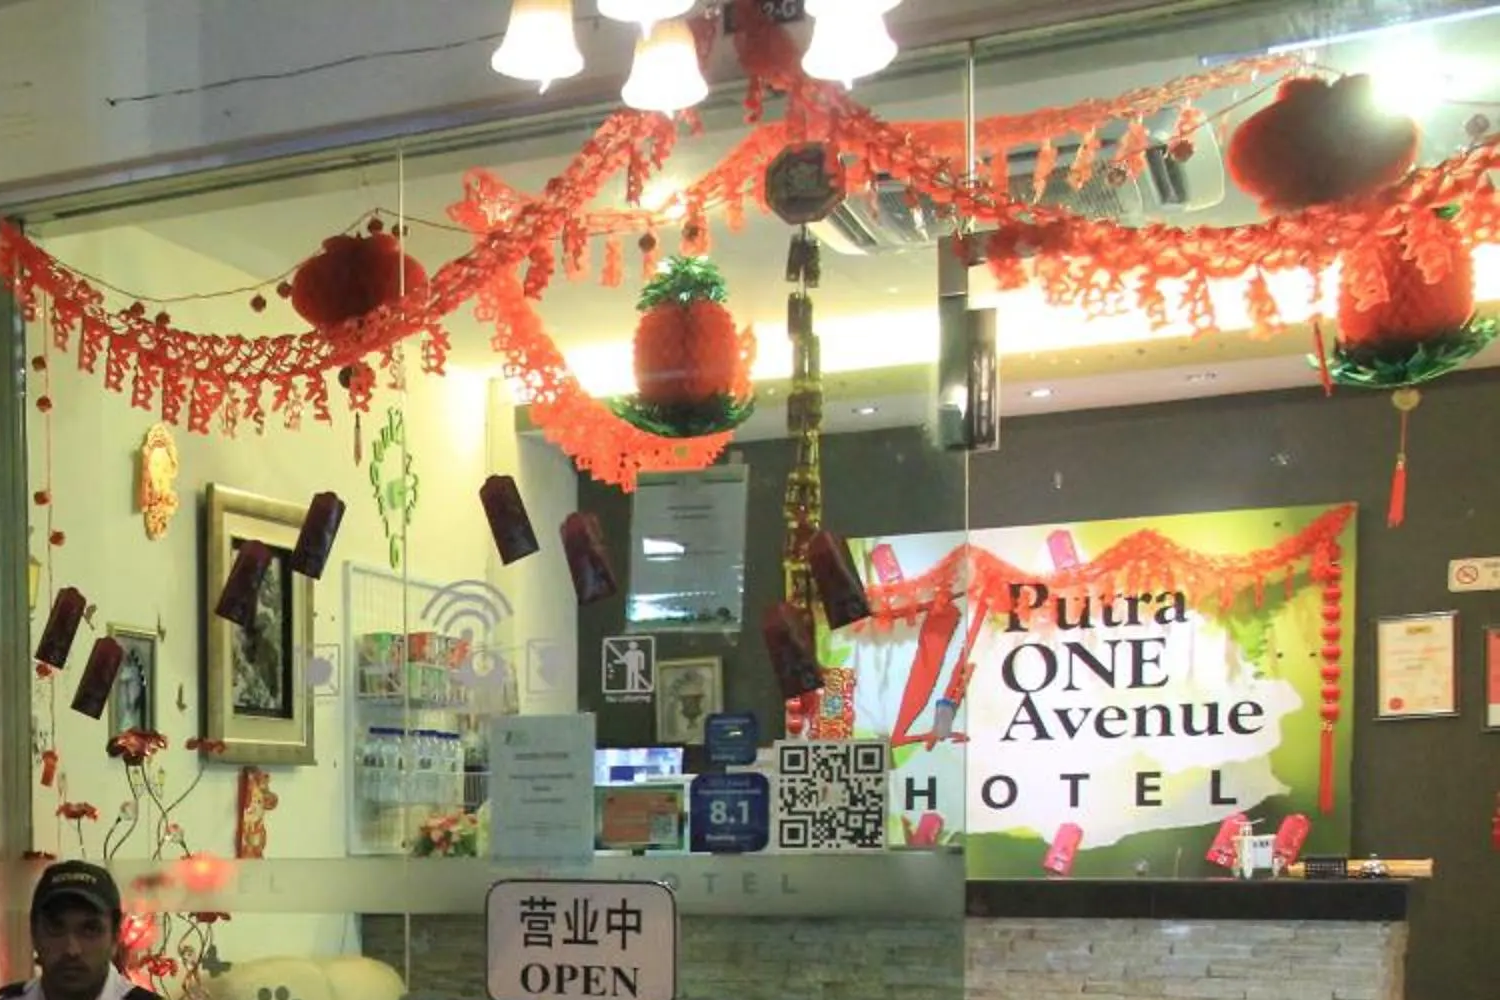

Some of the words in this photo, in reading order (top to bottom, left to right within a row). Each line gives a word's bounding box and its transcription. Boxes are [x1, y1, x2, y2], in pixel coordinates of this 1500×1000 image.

[1004, 582, 1190, 633] Putra
[1001, 637, 1170, 693] ONE
[999, 692, 1266, 741] Avenue
[710, 800, 750, 825] 8.1
[905, 769, 1238, 812] HOTEL
[519, 895, 642, 951] 营业中
[520, 962, 641, 999] OPEN
